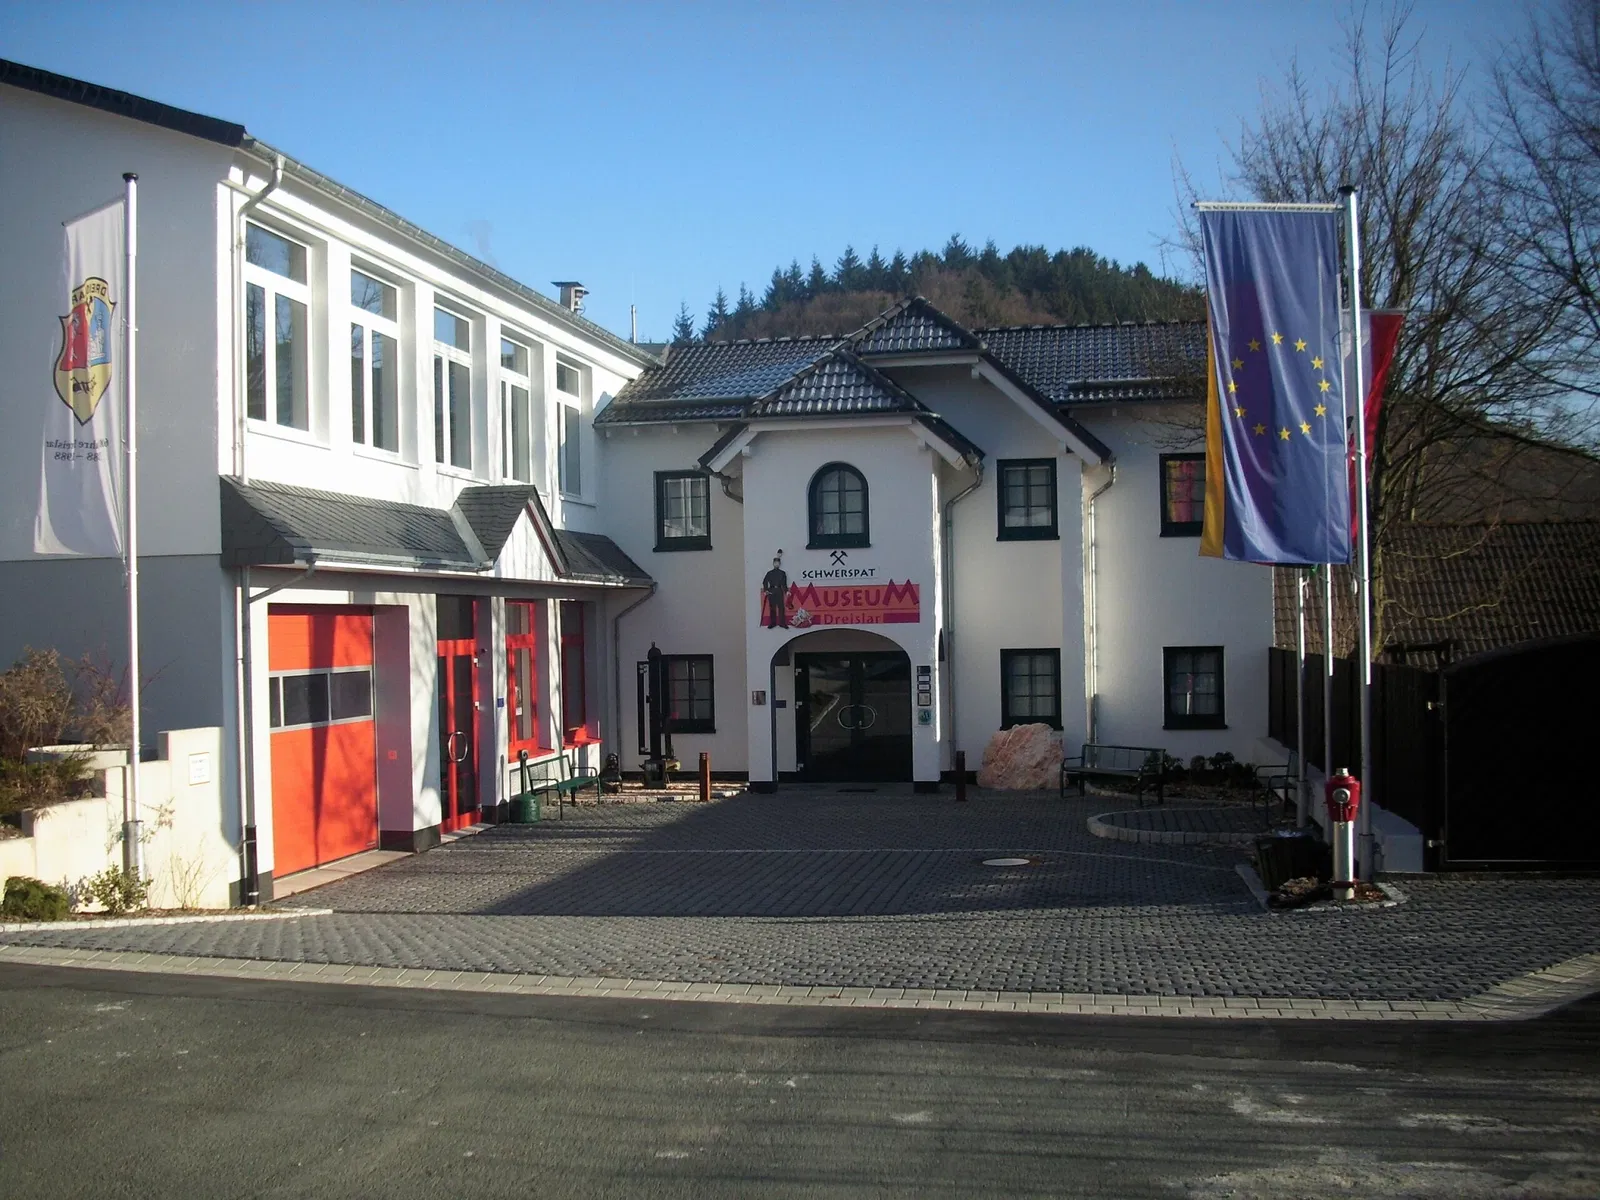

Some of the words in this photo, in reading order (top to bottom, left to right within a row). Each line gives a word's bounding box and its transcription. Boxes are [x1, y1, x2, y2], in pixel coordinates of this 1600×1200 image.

[802, 568, 876, 579] SCHWERSPAT
[786, 578, 920, 608] MUSEUM
[823, 613, 881, 625] Dreislar
